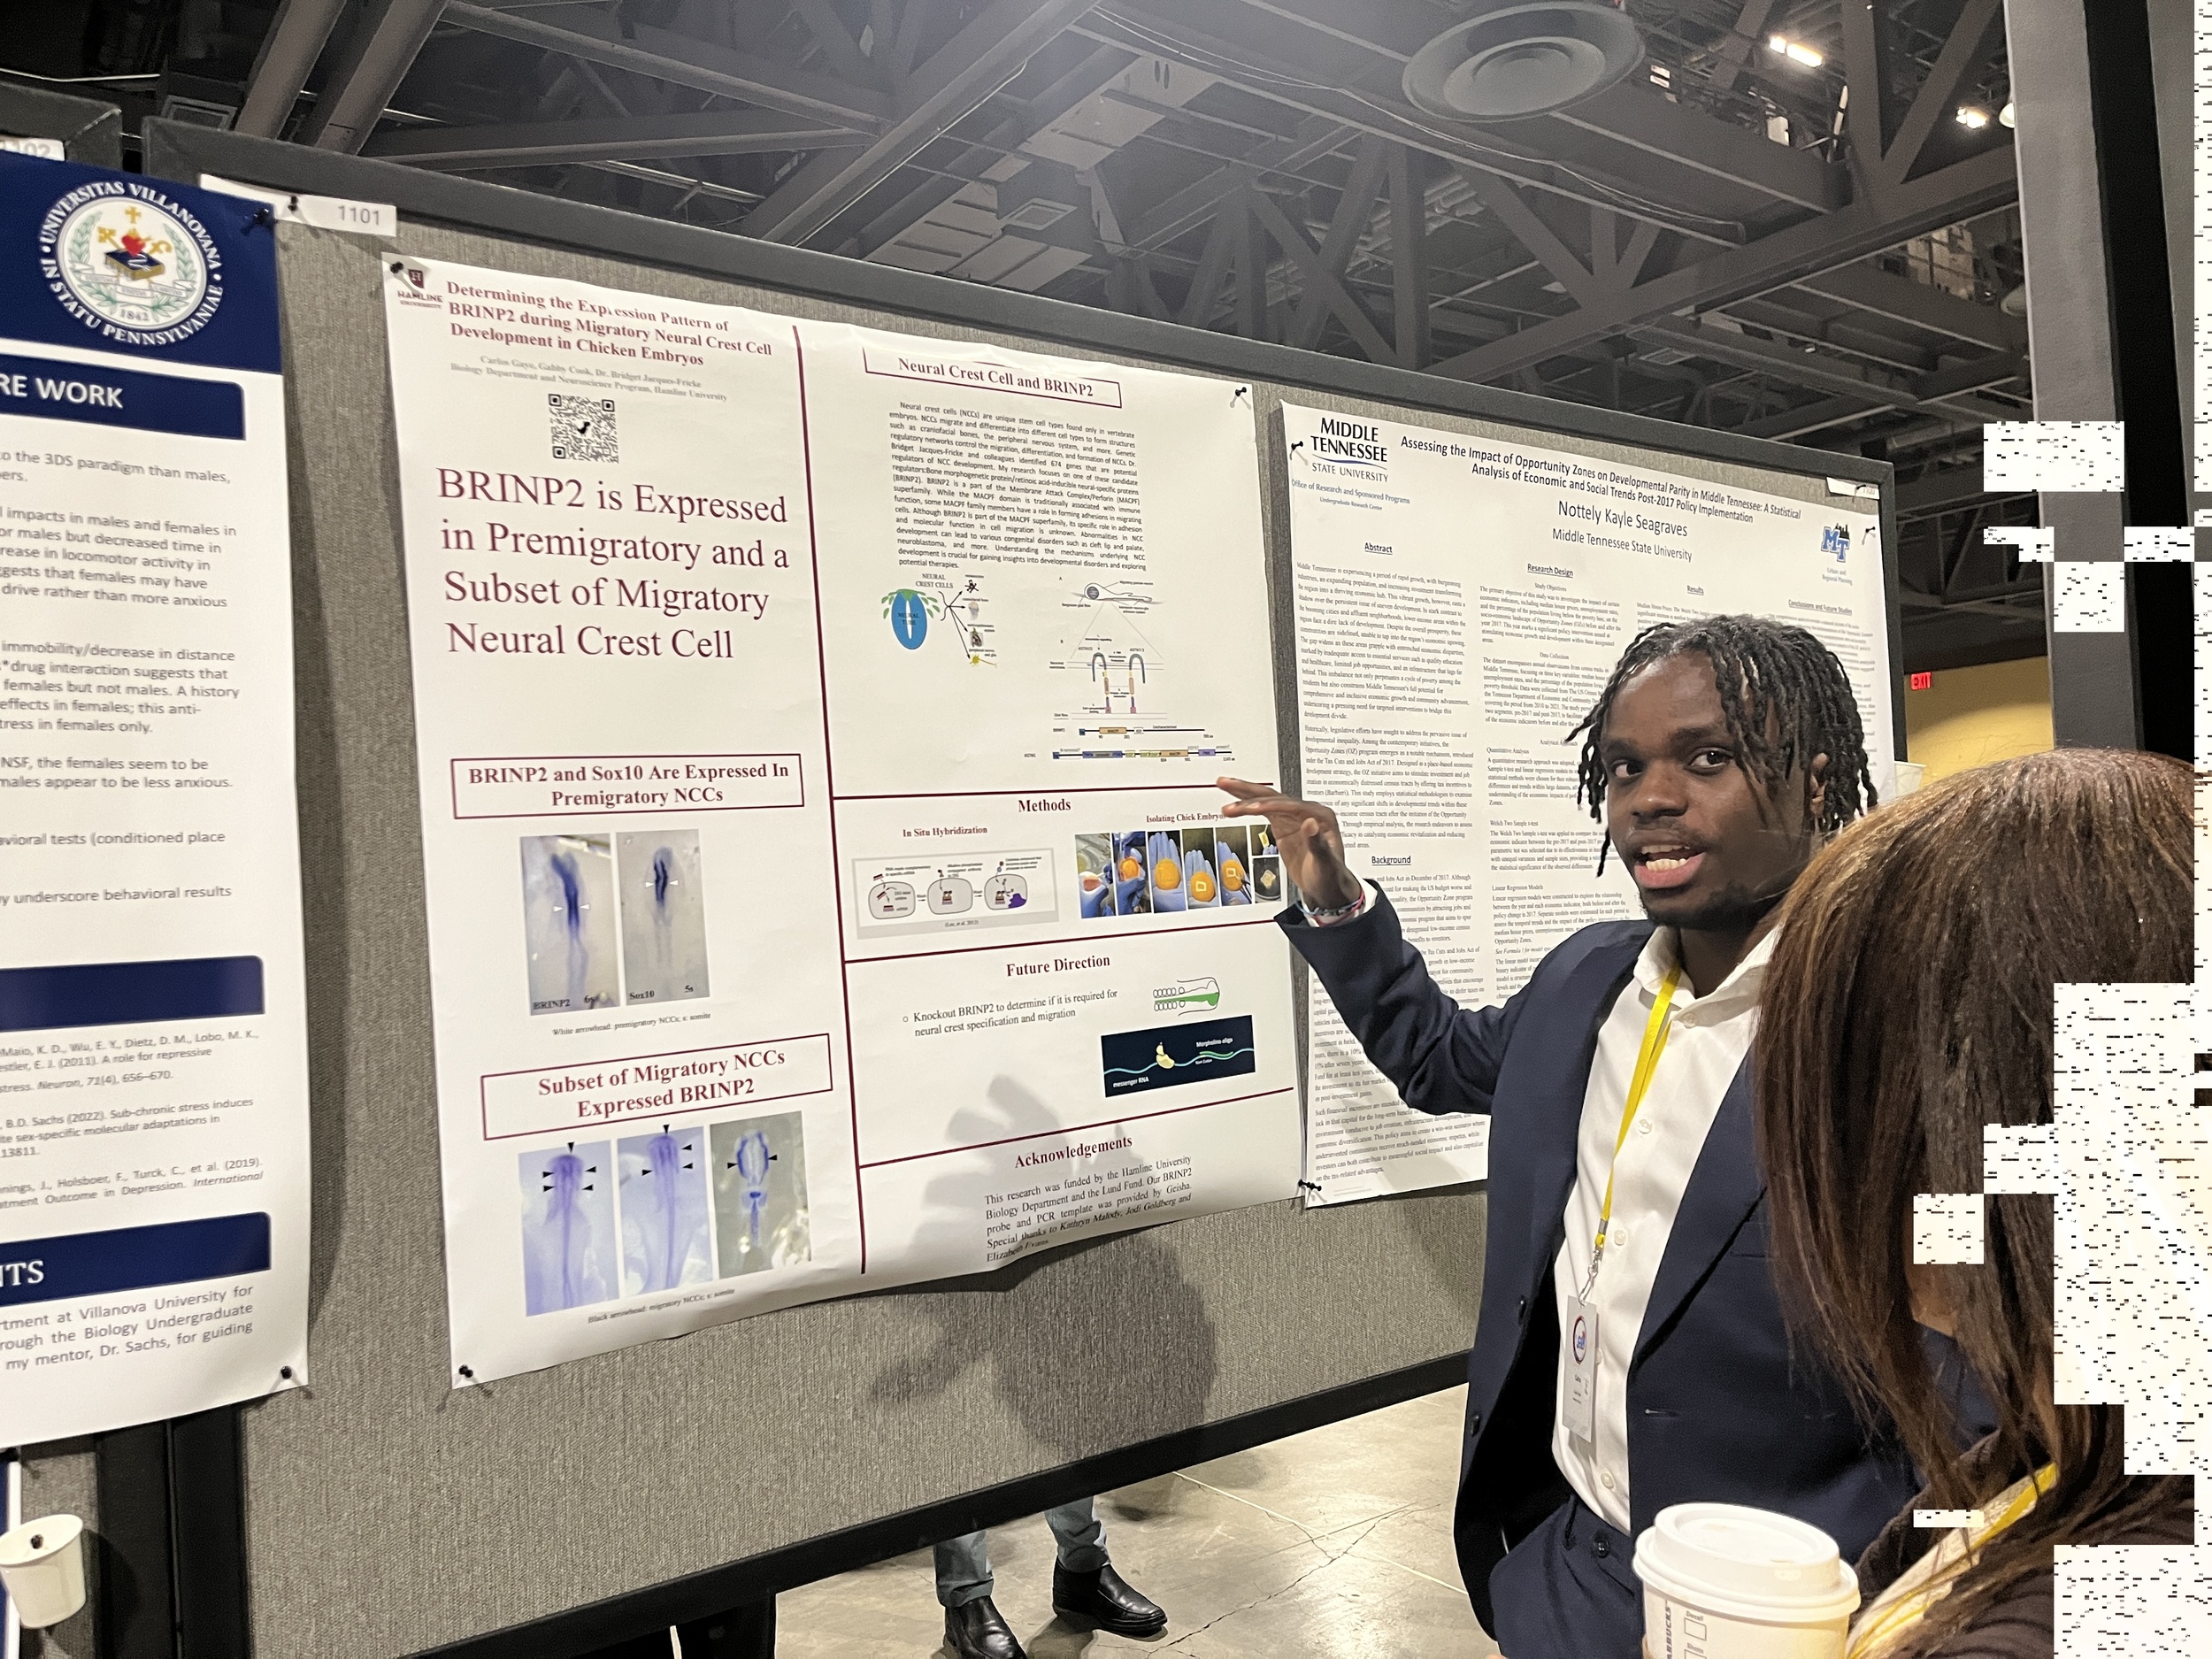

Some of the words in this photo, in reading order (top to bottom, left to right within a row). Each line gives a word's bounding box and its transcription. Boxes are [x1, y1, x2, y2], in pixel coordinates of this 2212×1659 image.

[40, 181, 125, 245] UNIVERSITAS
[128, 183, 221, 270] VILLANOVANA
[338, 205, 380, 225] 1101
[41, 258, 60, 279] IN
[50, 282, 100, 328] STATU
[397, 290, 443, 303] HAMLINE
[446, 280, 545, 309] Determining
[549, 296, 572, 310] the
[660, 311, 710, 328] Pattern
[715, 320, 728, 331] of
[103, 284, 223, 345] PENNSYLVANIAE
[119, 309, 150, 321] 1842
[448, 301, 515, 322] BRINP2
[519, 311, 572, 332] during
[575, 318, 649, 342] Migratory
[654, 328, 702, 346] Neural
[705, 335, 741, 351] Crest
[745, 341, 772, 355] Cell
[450, 322, 552, 347] Development
[557, 335, 571, 349] in
[576, 338, 636, 357] Chicken
[641, 346, 703, 366] Embryos
[898, 357, 944, 375] Neural
[949, 365, 984, 380] Crest
[987, 370, 1013, 385] Cell
[1017, 377, 1040, 388] and
[1043, 378, 1093, 396] BRINP2
[35, 377, 123, 408] WORK
[899, 401, 921, 411] Neural
[959, 409, 979, 419] (NCCs)
[1320, 417, 1378, 442] MIDDLE
[1310, 435, 1386, 462] TENNESSEE
[15, 452, 40, 463] the
[44, 455, 73, 466] 3DS
[77, 458, 144, 475] paradigm
[148, 465, 180, 478] than
[184, 470, 230, 484] males,
[1311, 462, 1335, 474] STATE
[1339, 466, 1388, 482] UNIVERSITY
[1401, 435, 1448, 456] Assessing
[1450, 443, 1465, 457] the
[1469, 446, 1501, 463] Impact
[1503, 453, 1513, 464] of
[1515, 455, 1570, 476] Opportunity
[1572, 465, 1595, 478] Zones
[1597, 472, 1607, 480] on
[1609, 472, 1667, 492] Developmental
[1669, 483, 1690, 499] Parity
[1691, 488, 1698, 498] in
[1700, 489, 1724, 503] Middle
[1726, 495, 1763, 511] Tennessee:
[1763, 503, 1769, 512] A
[1770, 503, 1801, 518] Statistical
[436, 467, 584, 507] BRINP2
[596, 480, 622, 510] is
[633, 483, 787, 523] Expressed
[1471, 464, 1509, 480] Analysis
[1511, 470, 1522, 480] of
[1524, 471, 1566, 488] Economic
[1569, 480, 1585, 490] and
[1586, 481, 1608, 495] Social
[1609, 486, 1635, 500] Trends
[1637, 491, 1674, 507] Post-2017
[1676, 498, 1697, 514] Policy
[1698, 503, 1753, 522] Implementation
[1558, 500, 1601, 525] Nottely
[1605, 508, 1632, 528] Kayle
[1635, 513, 1687, 536] Seagraves
[441, 518, 475, 549] in
[486, 522, 702, 570] Premigratory
[712, 539, 764, 566] and
[774, 549, 789, 568] a
[1364, 541, 1392, 553] Abstract
[1552, 527, 1584, 543] Middle
[1586, 533, 1629, 550] Tennessee
[1631, 540, 1651, 554] State
[1654, 543, 1692, 563] University
[1821, 526, 1850, 563] MT
[1526, 563, 1554, 575] Research
[1555, 566, 1573, 578] Design
[444, 571, 561, 603] Subset
[572, 576, 608, 605] of
[615, 578, 769, 620] Migratory
[1686, 585, 1704, 595] Results
[445, 622, 565, 654] Neural
[577, 626, 662, 656] Crest
[672, 628, 733, 657] Cell
[1911, 672, 1931, 689] EXIT
[469, 766, 548, 783] BRINP2
[553, 766, 586, 780] and
[592, 764, 642, 780] Sox10
[649, 765, 680, 780] Are
[685, 763, 767, 782] Expressed
[772, 763, 788, 777] In
[551, 789, 668, 809] Premigratory
[673, 787, 723, 803] NCCs
[1018, 798, 1071, 812] Methods
[902, 828, 911, 837] In
[932, 826, 987, 837] Hybridization
[1146, 814, 1175, 823] Isolating
[1371, 855, 1411, 865] Background
[1006, 963, 1049, 976] Future
[1054, 955, 1110, 971] Direction
[629, 990, 654, 999] Sox10
[913, 1009, 956, 1022] Knockout
[957, 1002, 994, 1017] BRINP2
[1006, 997, 1046, 1010] determine
[1048, 995, 1055, 1005] if
[1056, 995, 1062, 1004] it
[1064, 994, 1071, 1003] is
[1074, 989, 1104, 1003] required
[1106, 988, 1117, 998] for
[914, 1024, 941, 1036] neural
[943, 1022, 964, 1033] crest
[966, 1017, 1018, 1032] specification
[1020, 1011, 1035, 1023] and
[1037, 1010, 1075, 1022] migration
[539, 1073, 603, 1094] Subset
[609, 1068, 628, 1086] of
[634, 1060, 727, 1084] Migratory
[733, 1049, 784, 1070] NCCs
[1112, 1079, 1137, 1087] messenger
[578, 1088, 673, 1118] Expressed
[680, 1078, 754, 1102] BRINP2
[1015, 1136, 1132, 1168] Acknowledgements
[984, 1193, 1003, 1204] This
[1007, 1186, 1041, 1201] research
[1044, 1183, 1060, 1192] was
[1064, 1176, 1090, 1188] funded
[1094, 1175, 1102, 1184] by
[1122, 1164, 1152, 1177] Hamline
[1156, 1157, 1190, 1169] University
[5, 1358, 28, 1371] my
[35, 1349, 93, 1365] mentor,
[99, 1344, 119, 1356] Dr.
[125, 1337, 170, 1353] Sachs,
[176, 1332, 196, 1344] for
[201, 1322, 252, 1342] guiding
